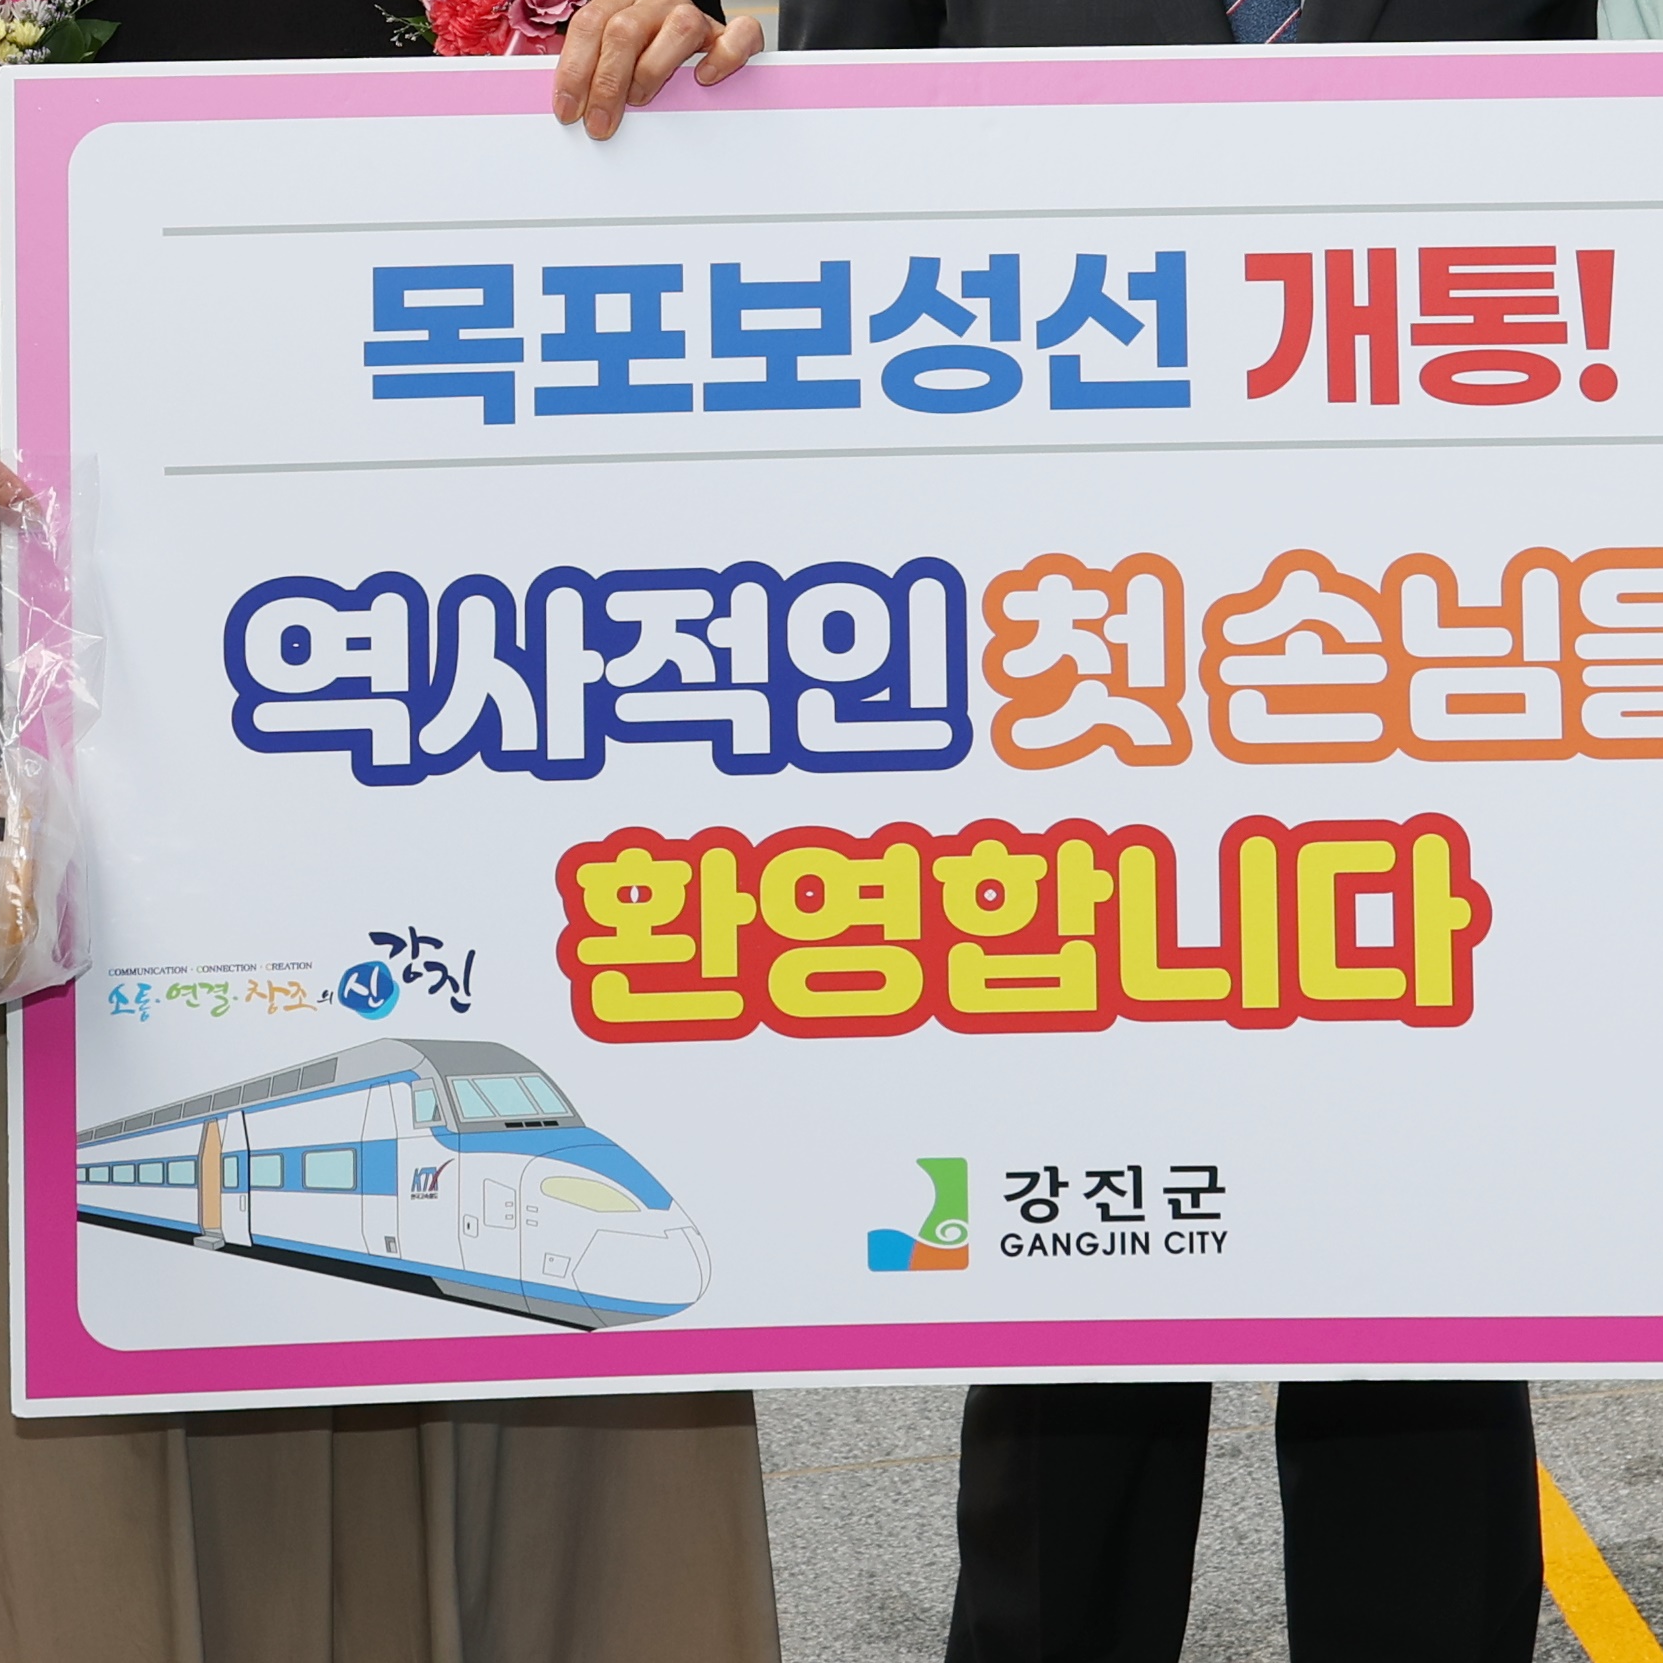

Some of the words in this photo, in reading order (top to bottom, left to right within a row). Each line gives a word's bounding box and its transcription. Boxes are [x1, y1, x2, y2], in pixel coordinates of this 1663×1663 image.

[363, 250, 1192, 426] 목포보성선
[1244, 245, 1619, 407] 개통!
[222, 556, 973, 788] 역사적인
[982, 551, 1189, 771] 첫
[555, 812, 1493, 1044] 환영합니다
[108, 966, 188, 977] COMMUNICATION
[195, 963, 257, 974] CONNECTION
[264, 961, 313, 972] CREATION
[411, 1158, 455, 1192] KTX
[1003, 1165, 1226, 1224] 강진군
[1000, 1232, 1150, 1257] GANGJIN
[1164, 1231, 1228, 1255] CITY
